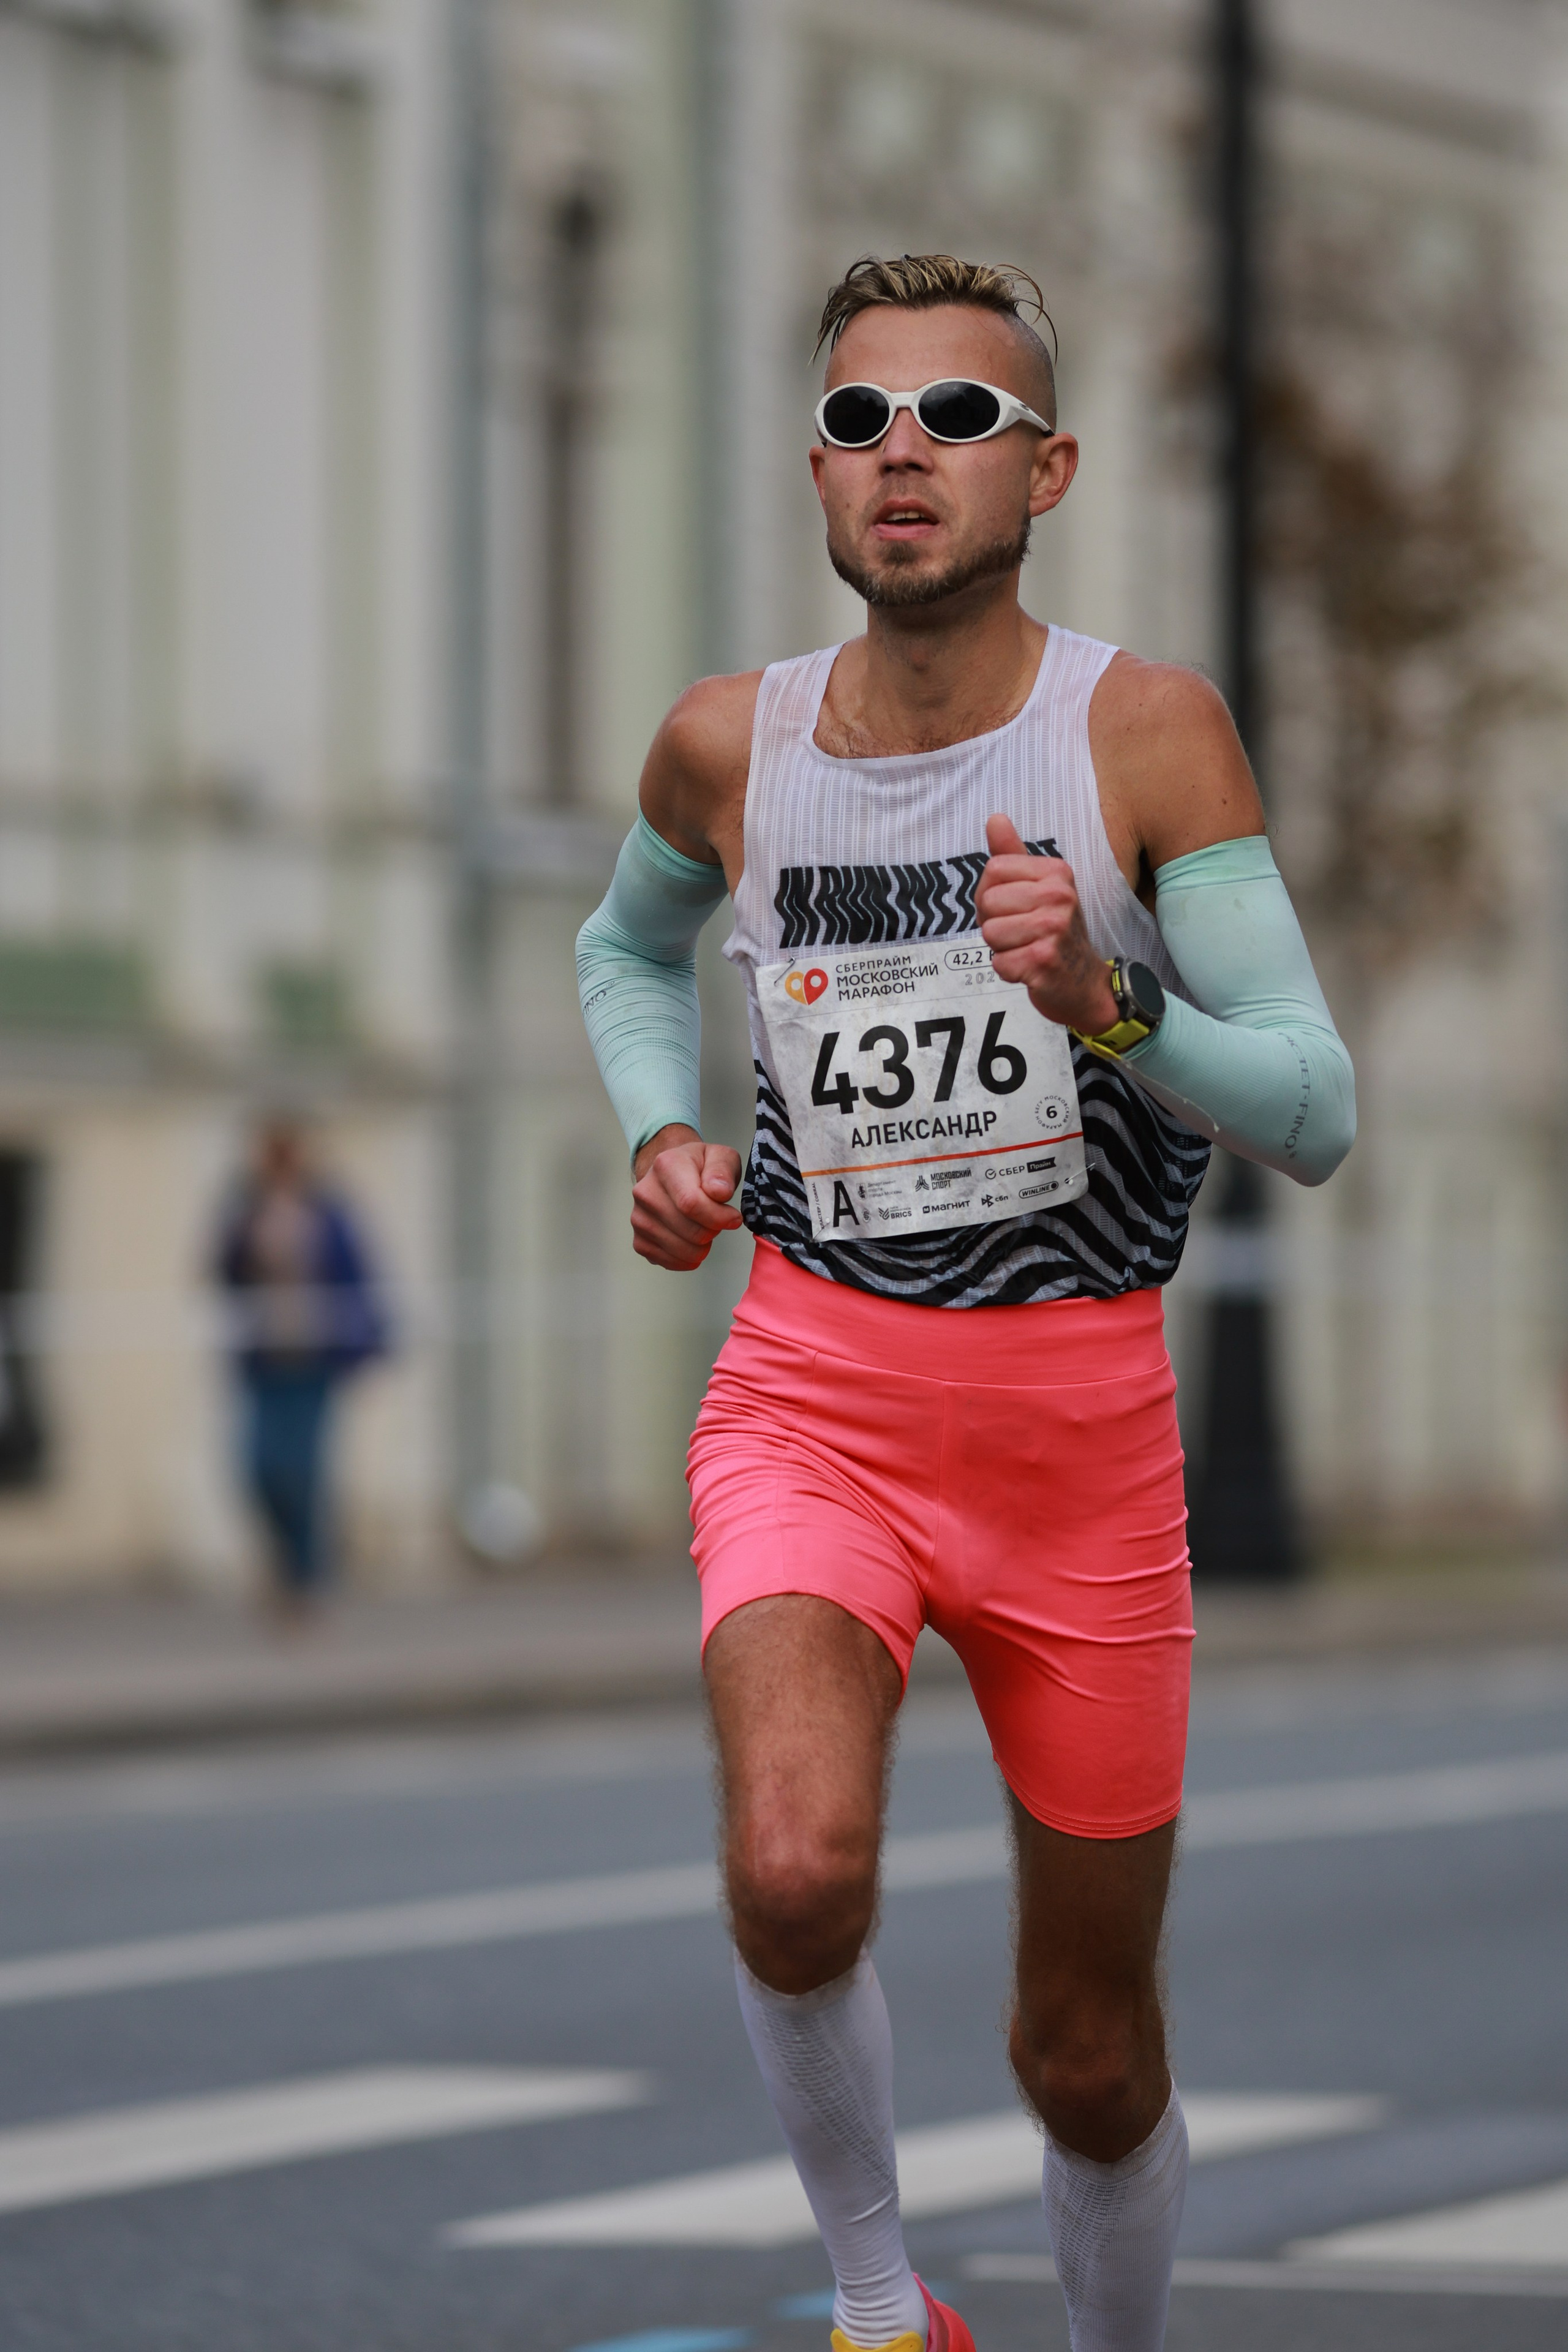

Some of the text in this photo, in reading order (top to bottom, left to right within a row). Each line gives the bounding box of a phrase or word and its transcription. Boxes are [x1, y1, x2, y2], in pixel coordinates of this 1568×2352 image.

[835, 956, 911, 973] СБЕРПРАЙМ
[952, 951, 982, 965] 42,2
[837, 962, 939, 987] МОСКОВСКИЙ
[965, 971, 995, 986] 202
[839, 981, 915, 1001] МАРАФОН
[810, 1010, 1027, 1115] 4376
[1046, 1105, 1058, 1119] 6
[851, 1110, 998, 1149] АЛЕКСАНДР
[930, 1167, 972, 1182] МОСКОВСКИЙ
[998, 1165, 1025, 1177] СБЕР
[932, 1180, 951, 1190] СПОРТ
[1022, 1185, 1050, 1197] WINLINE
[891, 1210, 912, 1219] BRICS
